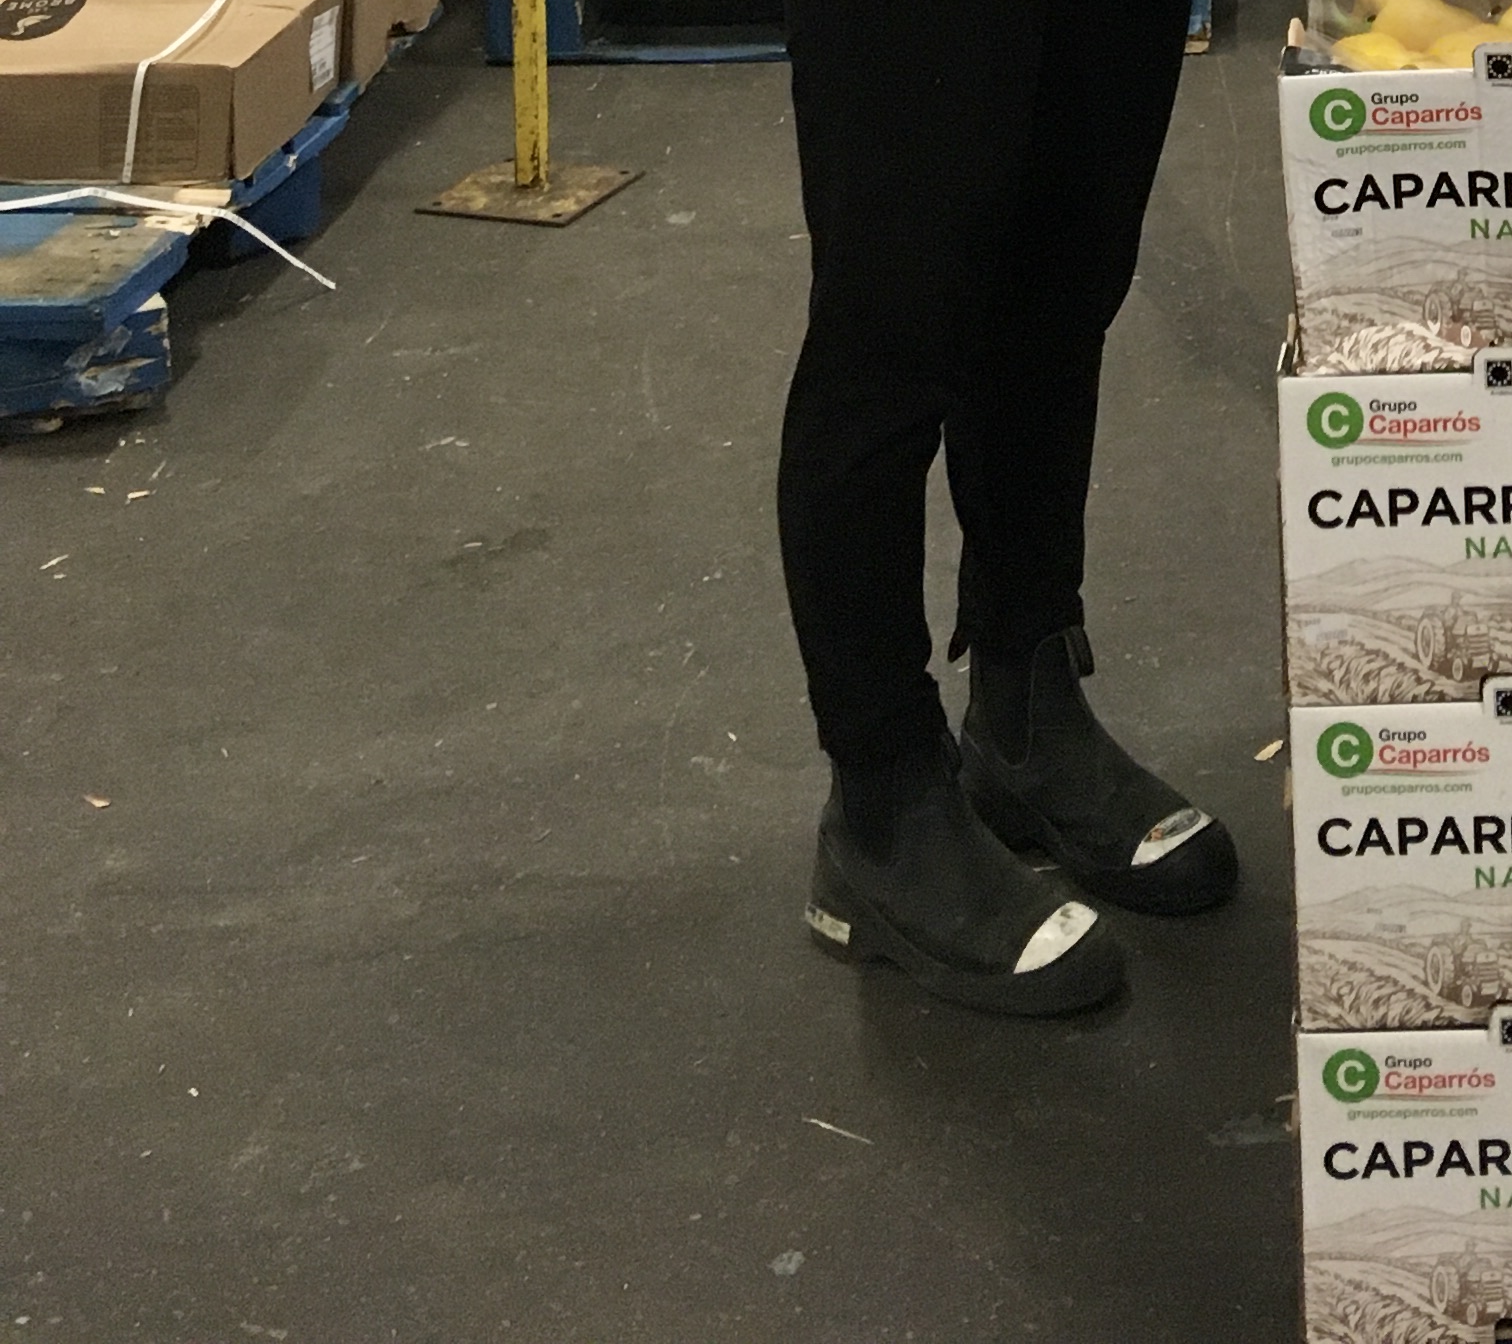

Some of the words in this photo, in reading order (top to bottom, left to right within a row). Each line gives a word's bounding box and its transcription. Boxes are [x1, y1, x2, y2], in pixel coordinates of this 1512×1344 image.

[1371, 92, 1419, 107] Grupo
[1371, 103, 1482, 126] Caparrós
[1336, 138, 1466, 157] grupocaparros.com
[1369, 400, 1417, 414] Grupo
[1369, 411, 1481, 438] Caparrós
[1331, 452, 1463, 466] grupocaparros.com
[1379, 729, 1426, 744] Grupo
[1379, 742, 1490, 768] Caparrós
[1341, 782, 1472, 795] grupocaparros.com
[1384, 1055, 1432, 1071] Grupo
[1384, 1067, 1495, 1093] Caparrós
[1347, 1106, 1478, 1120] grupocaparros.com
